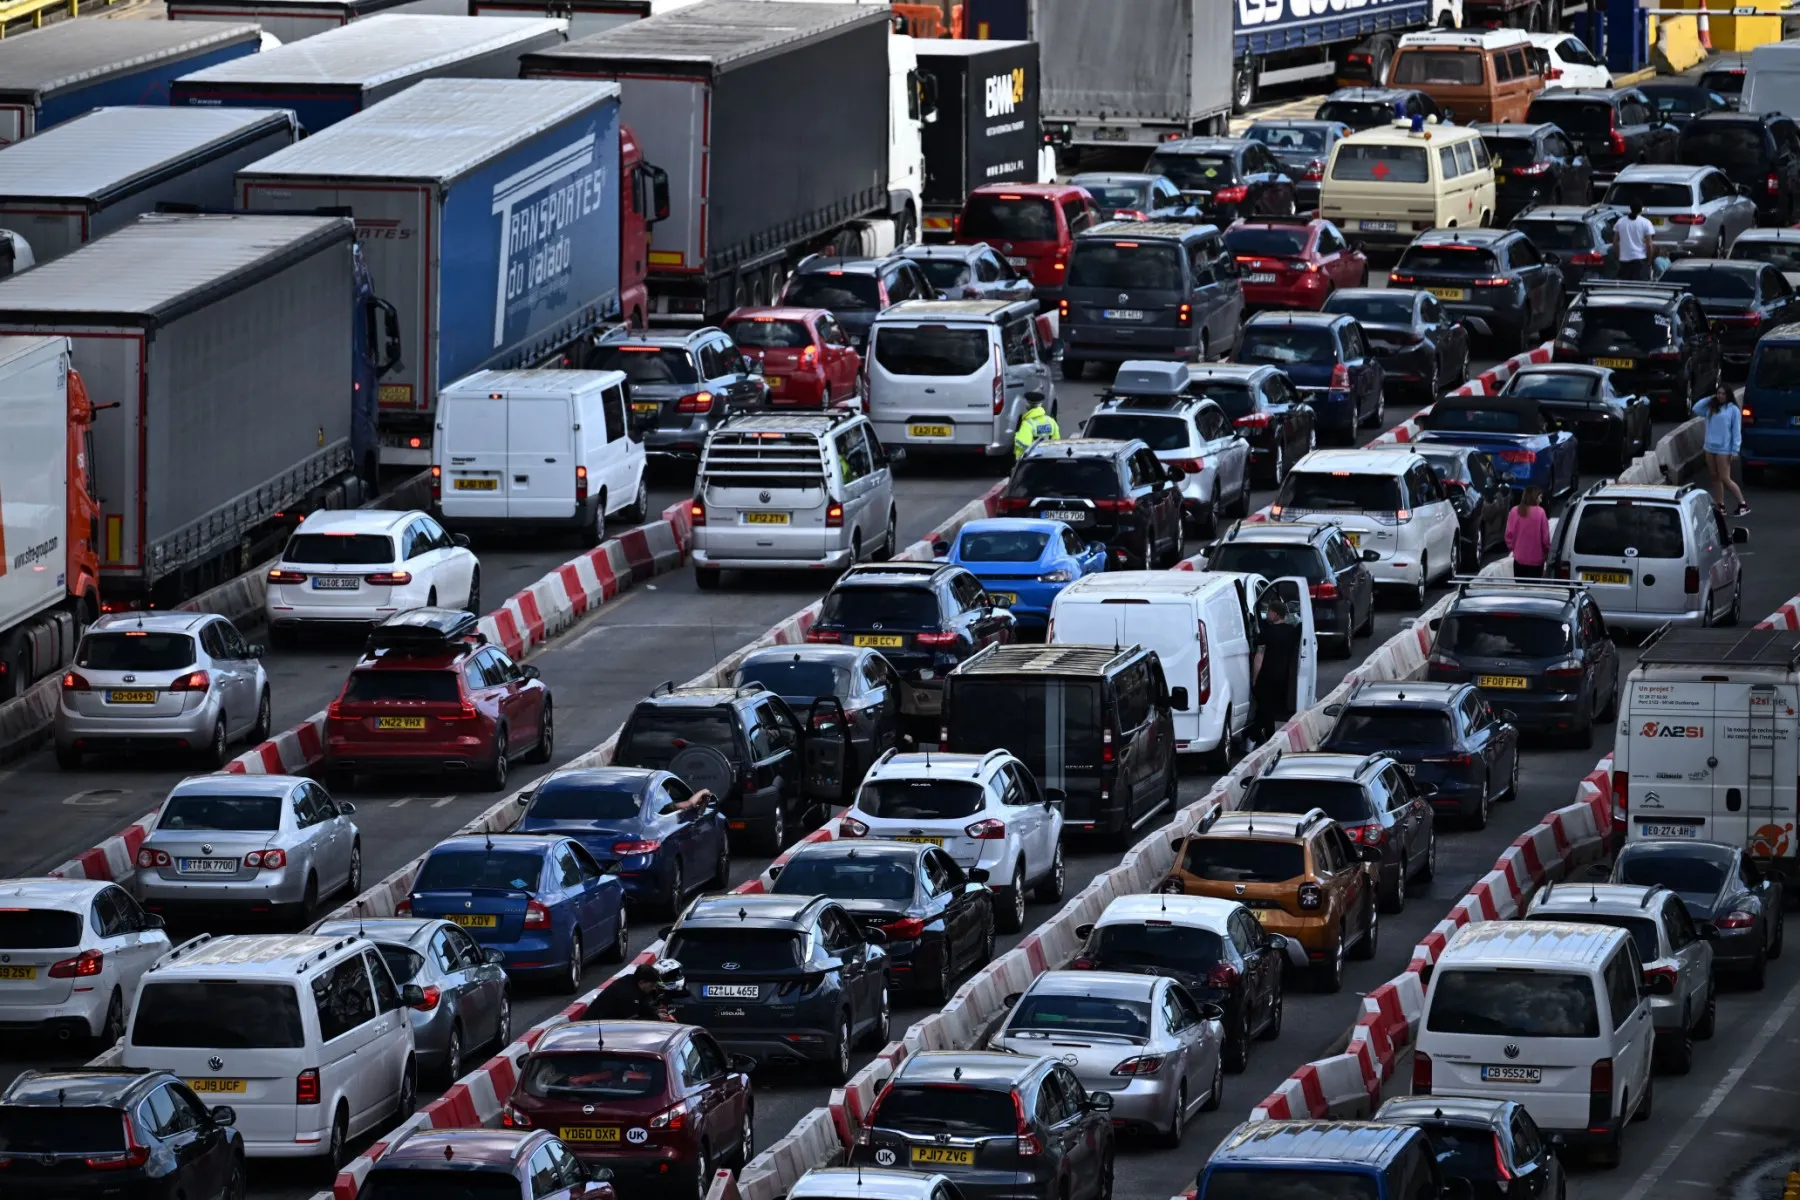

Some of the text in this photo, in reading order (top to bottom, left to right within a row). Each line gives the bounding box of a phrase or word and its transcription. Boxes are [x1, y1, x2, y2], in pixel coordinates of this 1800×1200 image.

[506, 260, 523, 300] do
[859, 636, 897, 645] PJ18 CCY
[1480, 677, 1523, 686] EF08 FFM
[112, 691, 152, 701] GD-049-D
[1658, 726, 1704, 740] A2SI
[187, 860, 233, 870] RT DK 7700
[12, 968, 31, 978] ZSY
[708, 986, 758, 996] GZ LL 465E
[1488, 1068, 1539, 1079] CB 9552 MC
[193, 1080, 240, 1090] GJ19 UCF
[564, 1128, 616, 1140] YD60 OXR
[628, 1131, 643, 1140] UK
[878, 1152, 893, 1163] UK
[919, 1149, 967, 1162] PJ17 ZVG
